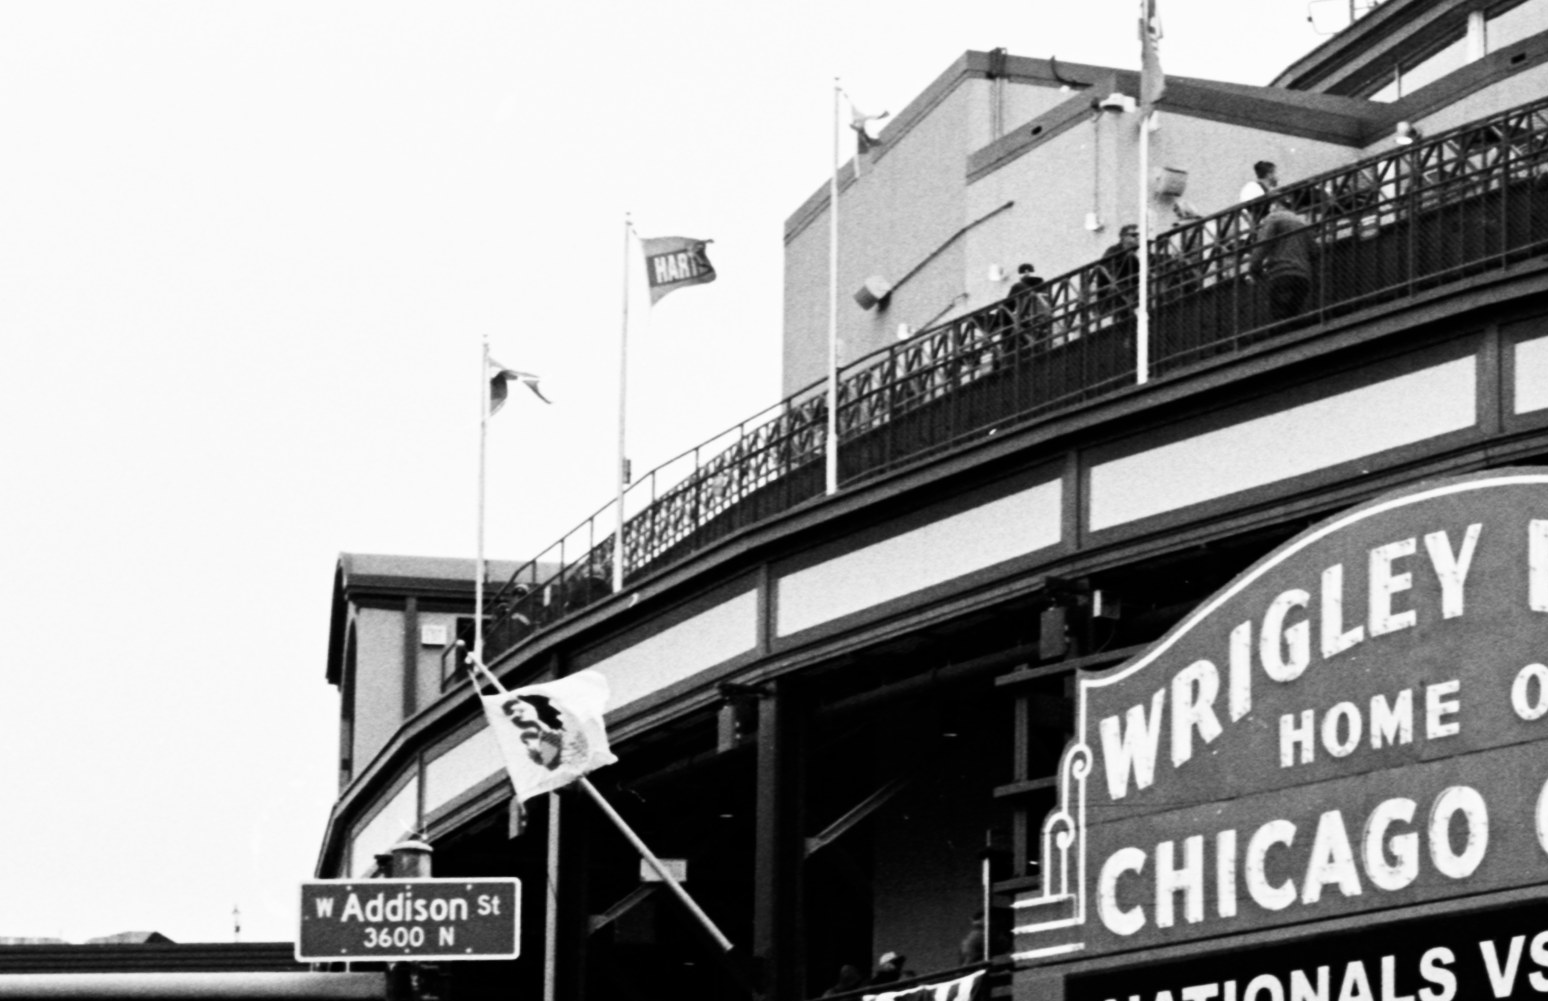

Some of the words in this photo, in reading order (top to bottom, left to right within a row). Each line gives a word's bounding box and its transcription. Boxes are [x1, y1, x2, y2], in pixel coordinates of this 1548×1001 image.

[1099, 523, 1483, 799] WRIGLEY
[1279, 679, 1461, 767] HOME
[1096, 786, 1490, 936] CHICAGO
[315, 898, 334, 918] W
[340, 892, 468, 922] Addison
[477, 895, 501, 916] St
[363, 926, 425, 948] 3600
[438, 926, 455, 947] N
